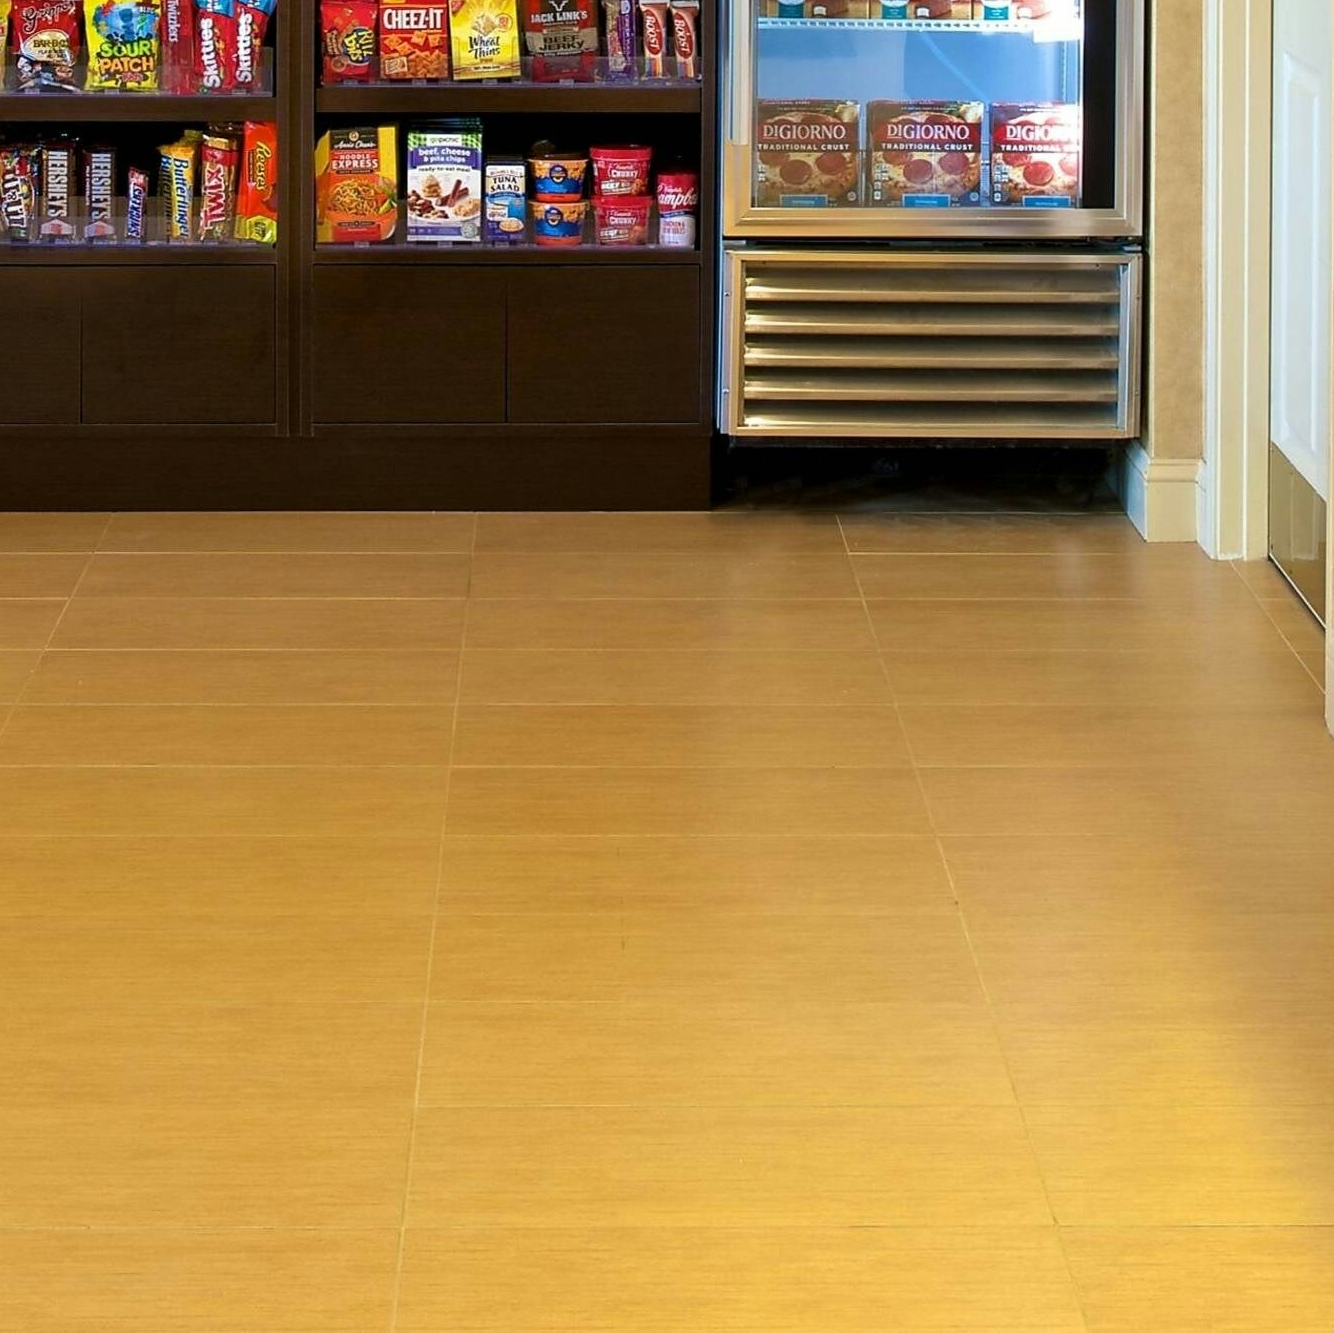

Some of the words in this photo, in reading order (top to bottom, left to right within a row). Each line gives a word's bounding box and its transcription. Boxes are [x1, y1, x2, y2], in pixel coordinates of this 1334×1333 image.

[530, 13, 555, 24] JACK
[556, 10, 588, 22] LINK'S
[468, 35, 500, 48] Wheat
[543, 34, 581, 44] BEEF
[100, 41, 152, 57] SOUR
[200, 18, 221, 88] Skittles
[235, 12, 253, 83] Skittles
[468, 46, 501, 60] Thins
[538, 41, 585, 52] JERKY
[99, 57, 154, 74] PATCH
[419, 148, 440, 156] beef,
[441, 148, 471, 156] cheese
[758, 143, 818, 151] TRADITIONAL
[821, 143, 850, 151] CRUST
[882, 143, 941, 151] TRADITIONAL
[944, 143, 974, 151] CRUST
[1001, 144, 1061, 152] TRADITIONAL
[332, 159, 379, 170] EXPRESS
[430, 155, 445, 163] pita
[447, 155, 466, 163] chips
[255, 141, 272, 192] Reese's
[46, 150, 69, 218] HERSHEY'S
[493, 176, 517, 184] TUNA
[91, 153, 112, 221] HERSHEY'S
[490, 184, 520, 193] SALAD
[174, 157, 190, 238] Butterfinger
[128, 180, 144, 238] SNICKERS
